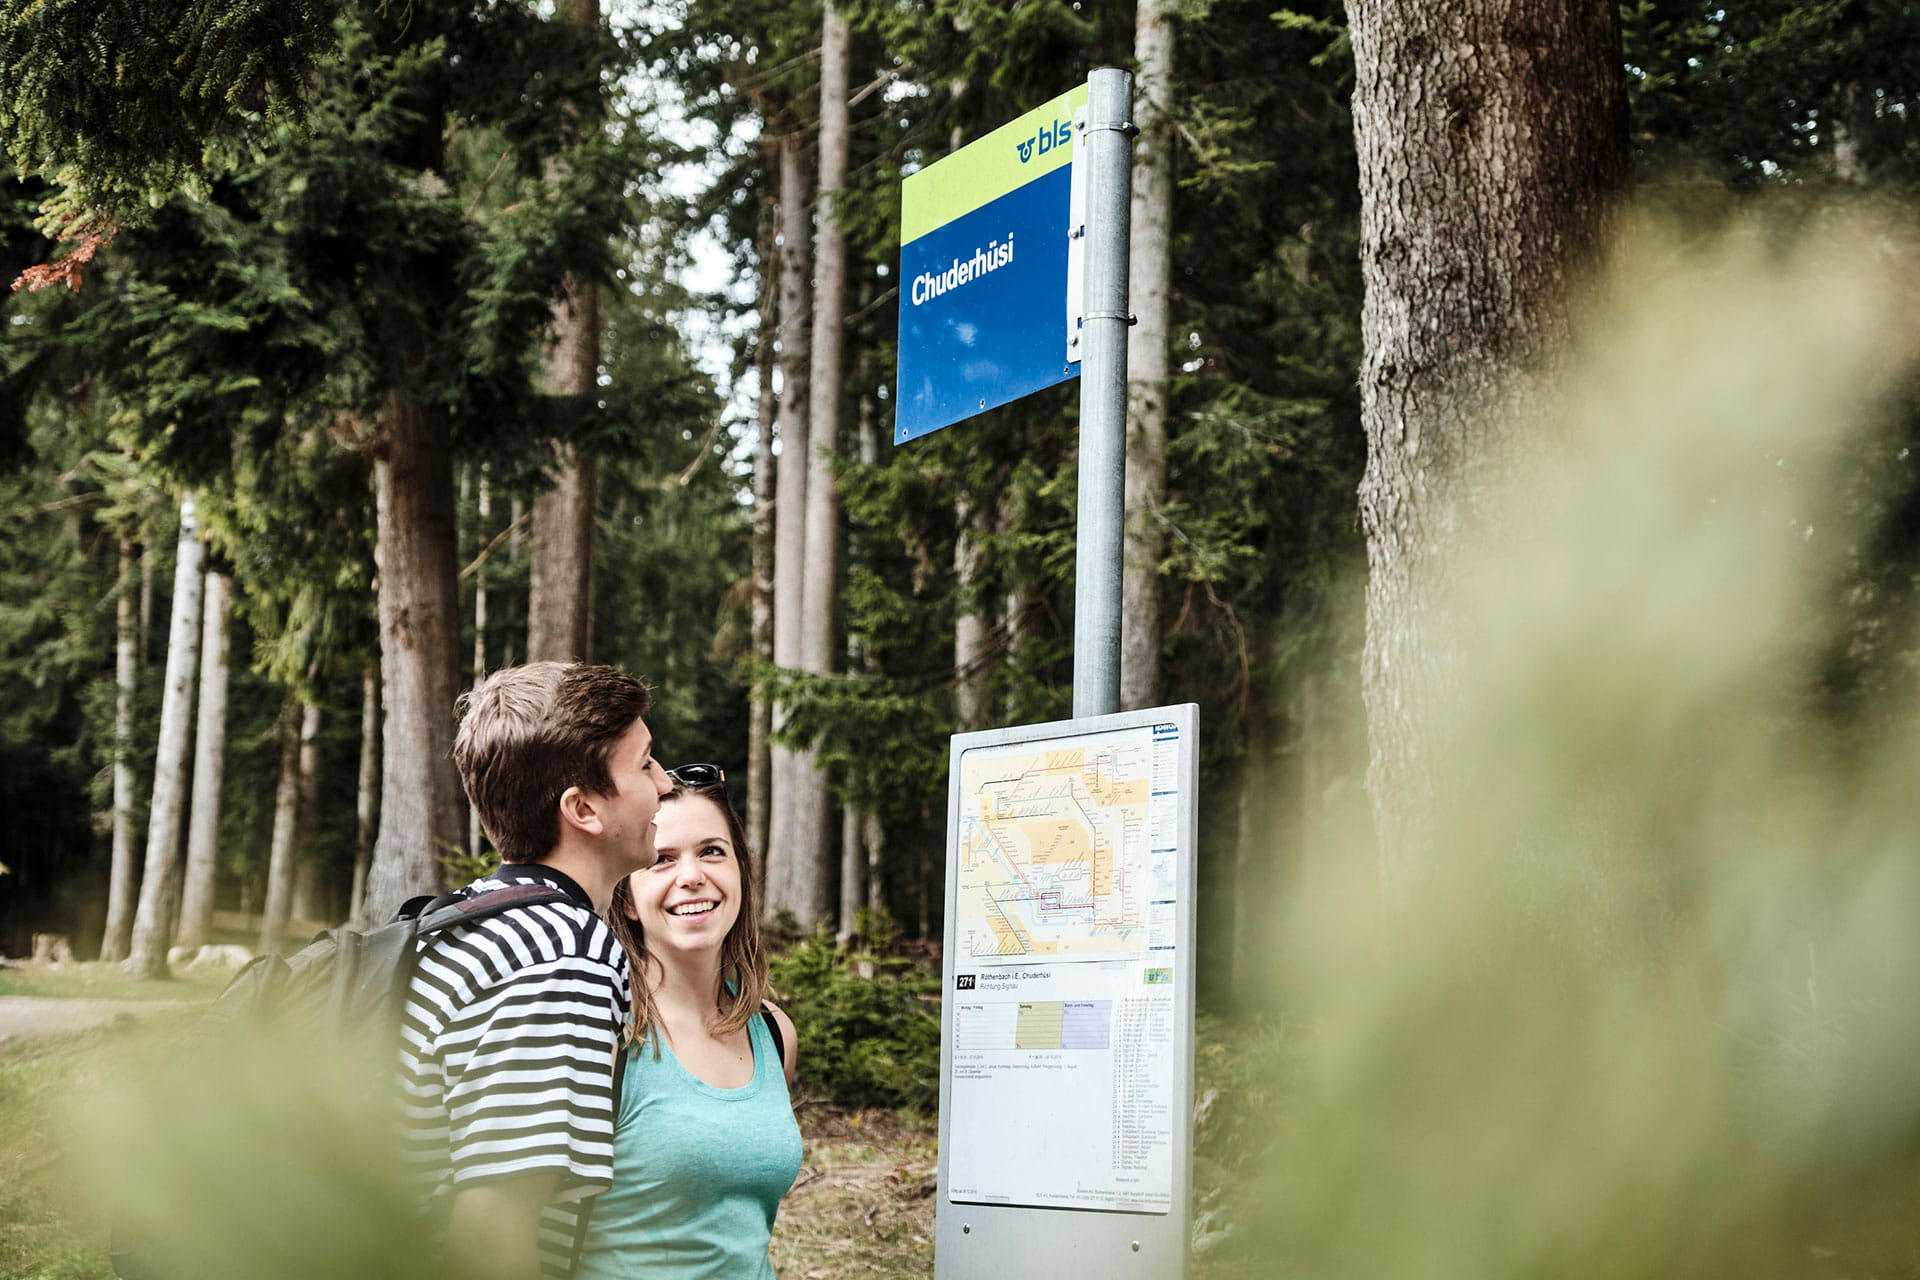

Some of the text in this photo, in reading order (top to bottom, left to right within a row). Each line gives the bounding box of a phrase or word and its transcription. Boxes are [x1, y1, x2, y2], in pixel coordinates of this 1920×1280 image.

[1038, 119, 1072, 155] bls
[911, 232, 1014, 306] Chuderhüsi
[959, 976, 973, 988] 271
